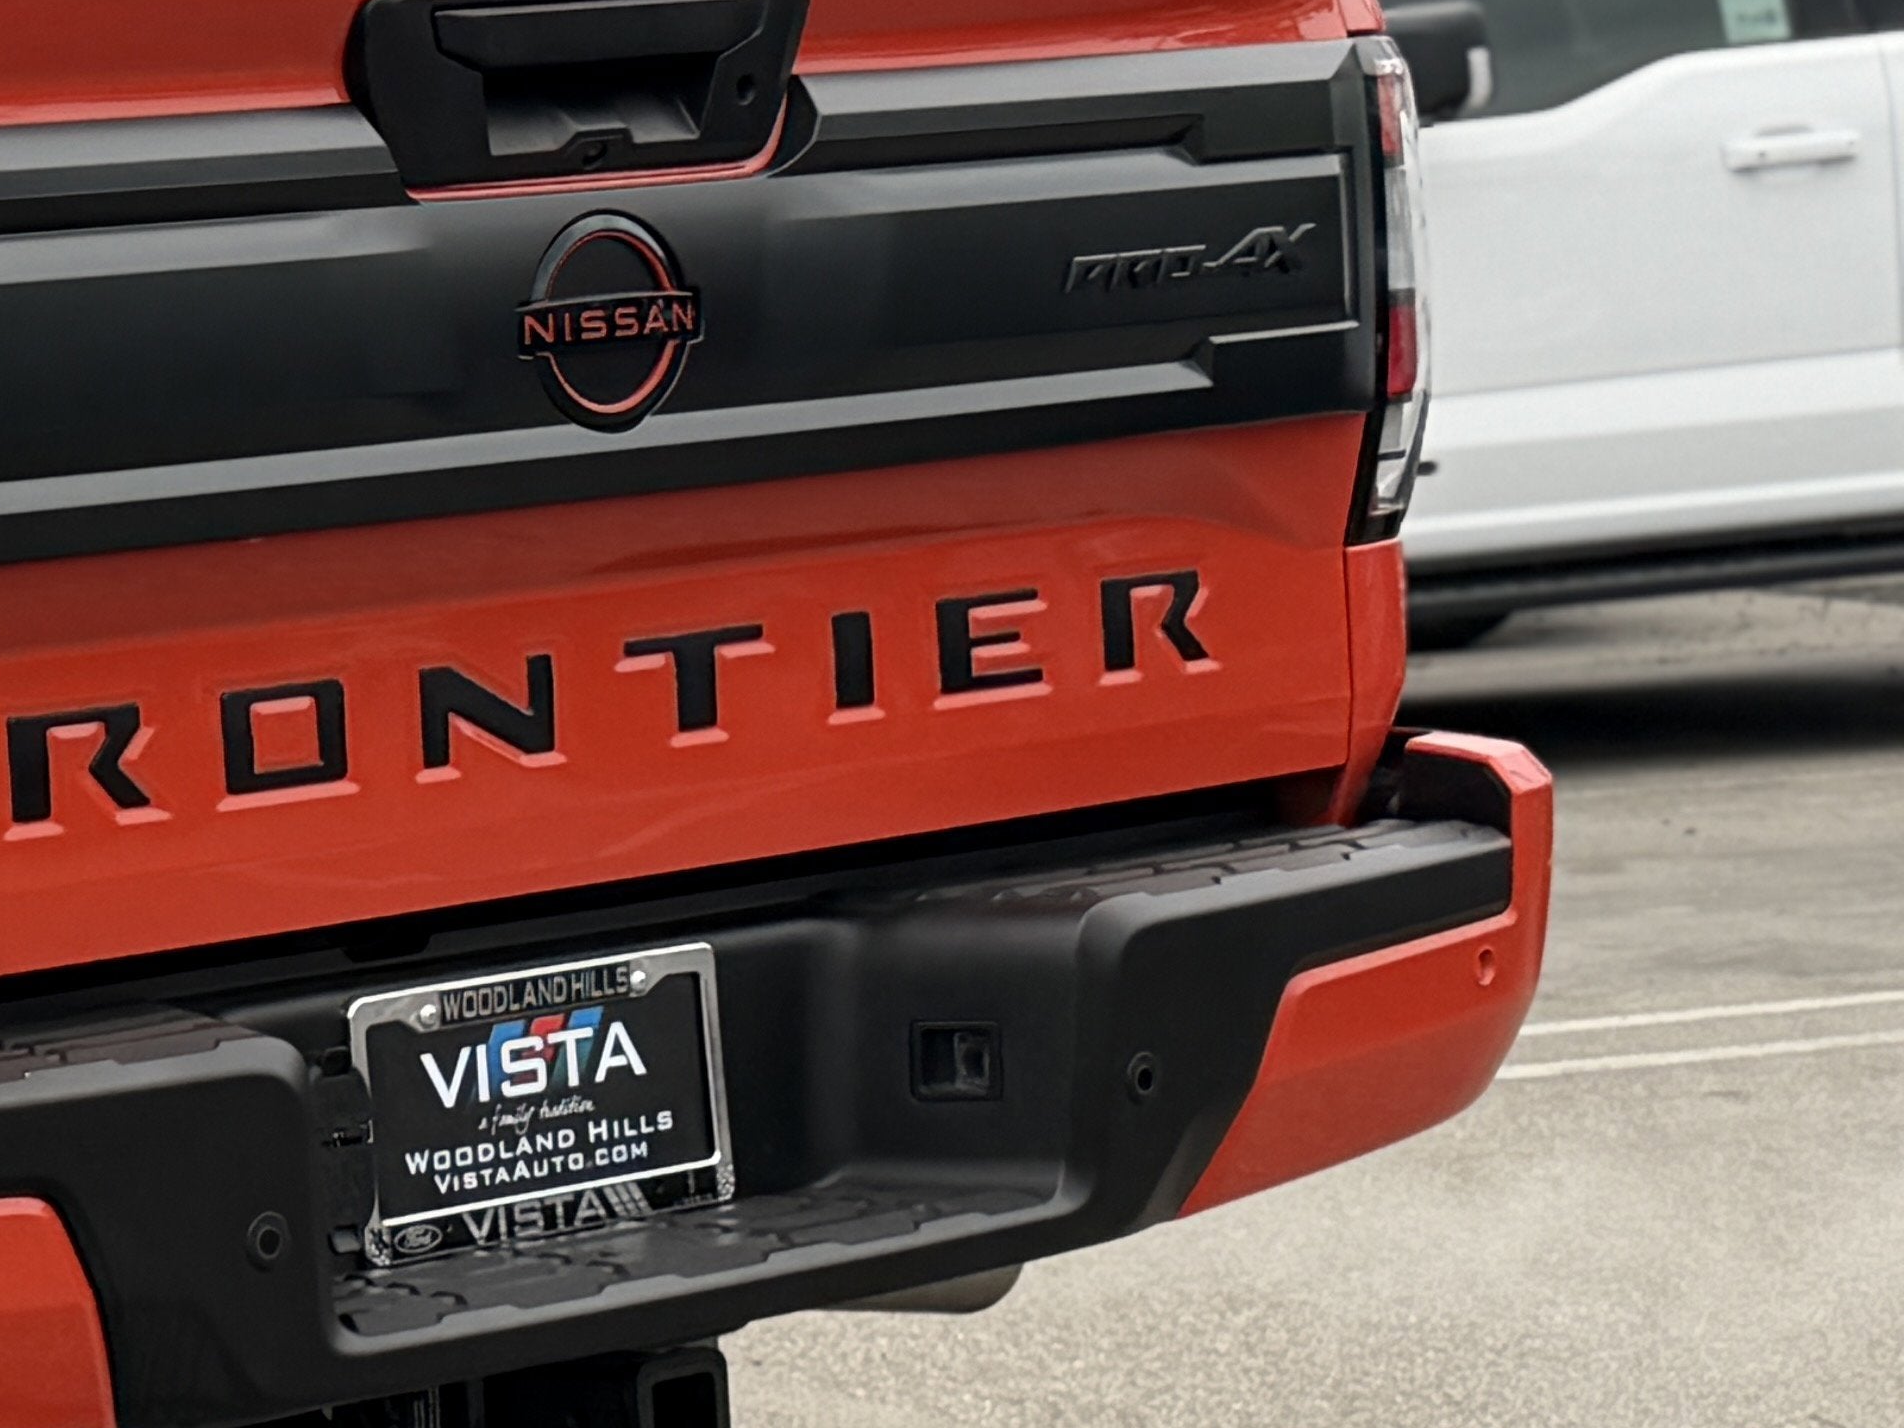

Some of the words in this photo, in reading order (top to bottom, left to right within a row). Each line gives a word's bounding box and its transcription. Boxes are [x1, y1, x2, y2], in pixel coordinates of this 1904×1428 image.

[523, 300, 694, 345] NISSAN
[442, 977, 567, 1020] WOODLAND
[569, 965, 629, 1001] HILLS
[419, 1020, 648, 1109] VISTA
[461, 1187, 607, 1246] VISTA
